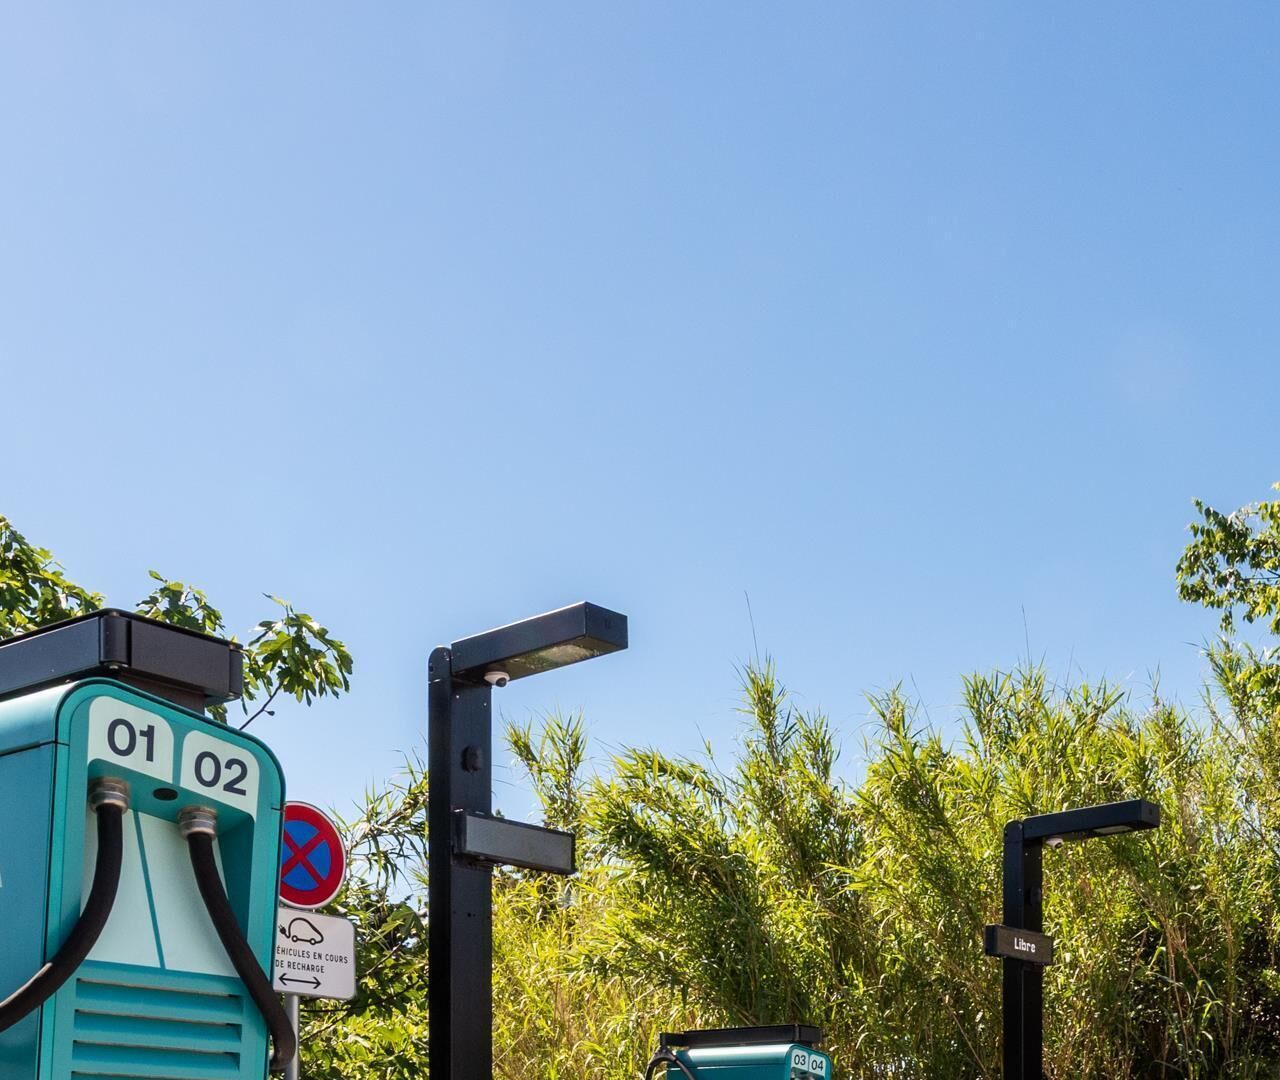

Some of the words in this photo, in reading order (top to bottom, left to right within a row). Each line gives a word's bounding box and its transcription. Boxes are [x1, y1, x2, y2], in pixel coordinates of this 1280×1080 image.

[107, 718, 155, 763] 01
[194, 751, 248, 796] 02
[1014, 937, 1036, 953] Libre
[276, 945, 311, 959] ÉHICULES
[313, 952, 322, 960] EN
[325, 953, 348, 964] COURS
[275, 959, 284, 968] DE
[287, 961, 325, 973] RECHARGE
[793, 1054, 806, 1066] 03
[811, 1060, 824, 1071] 04
